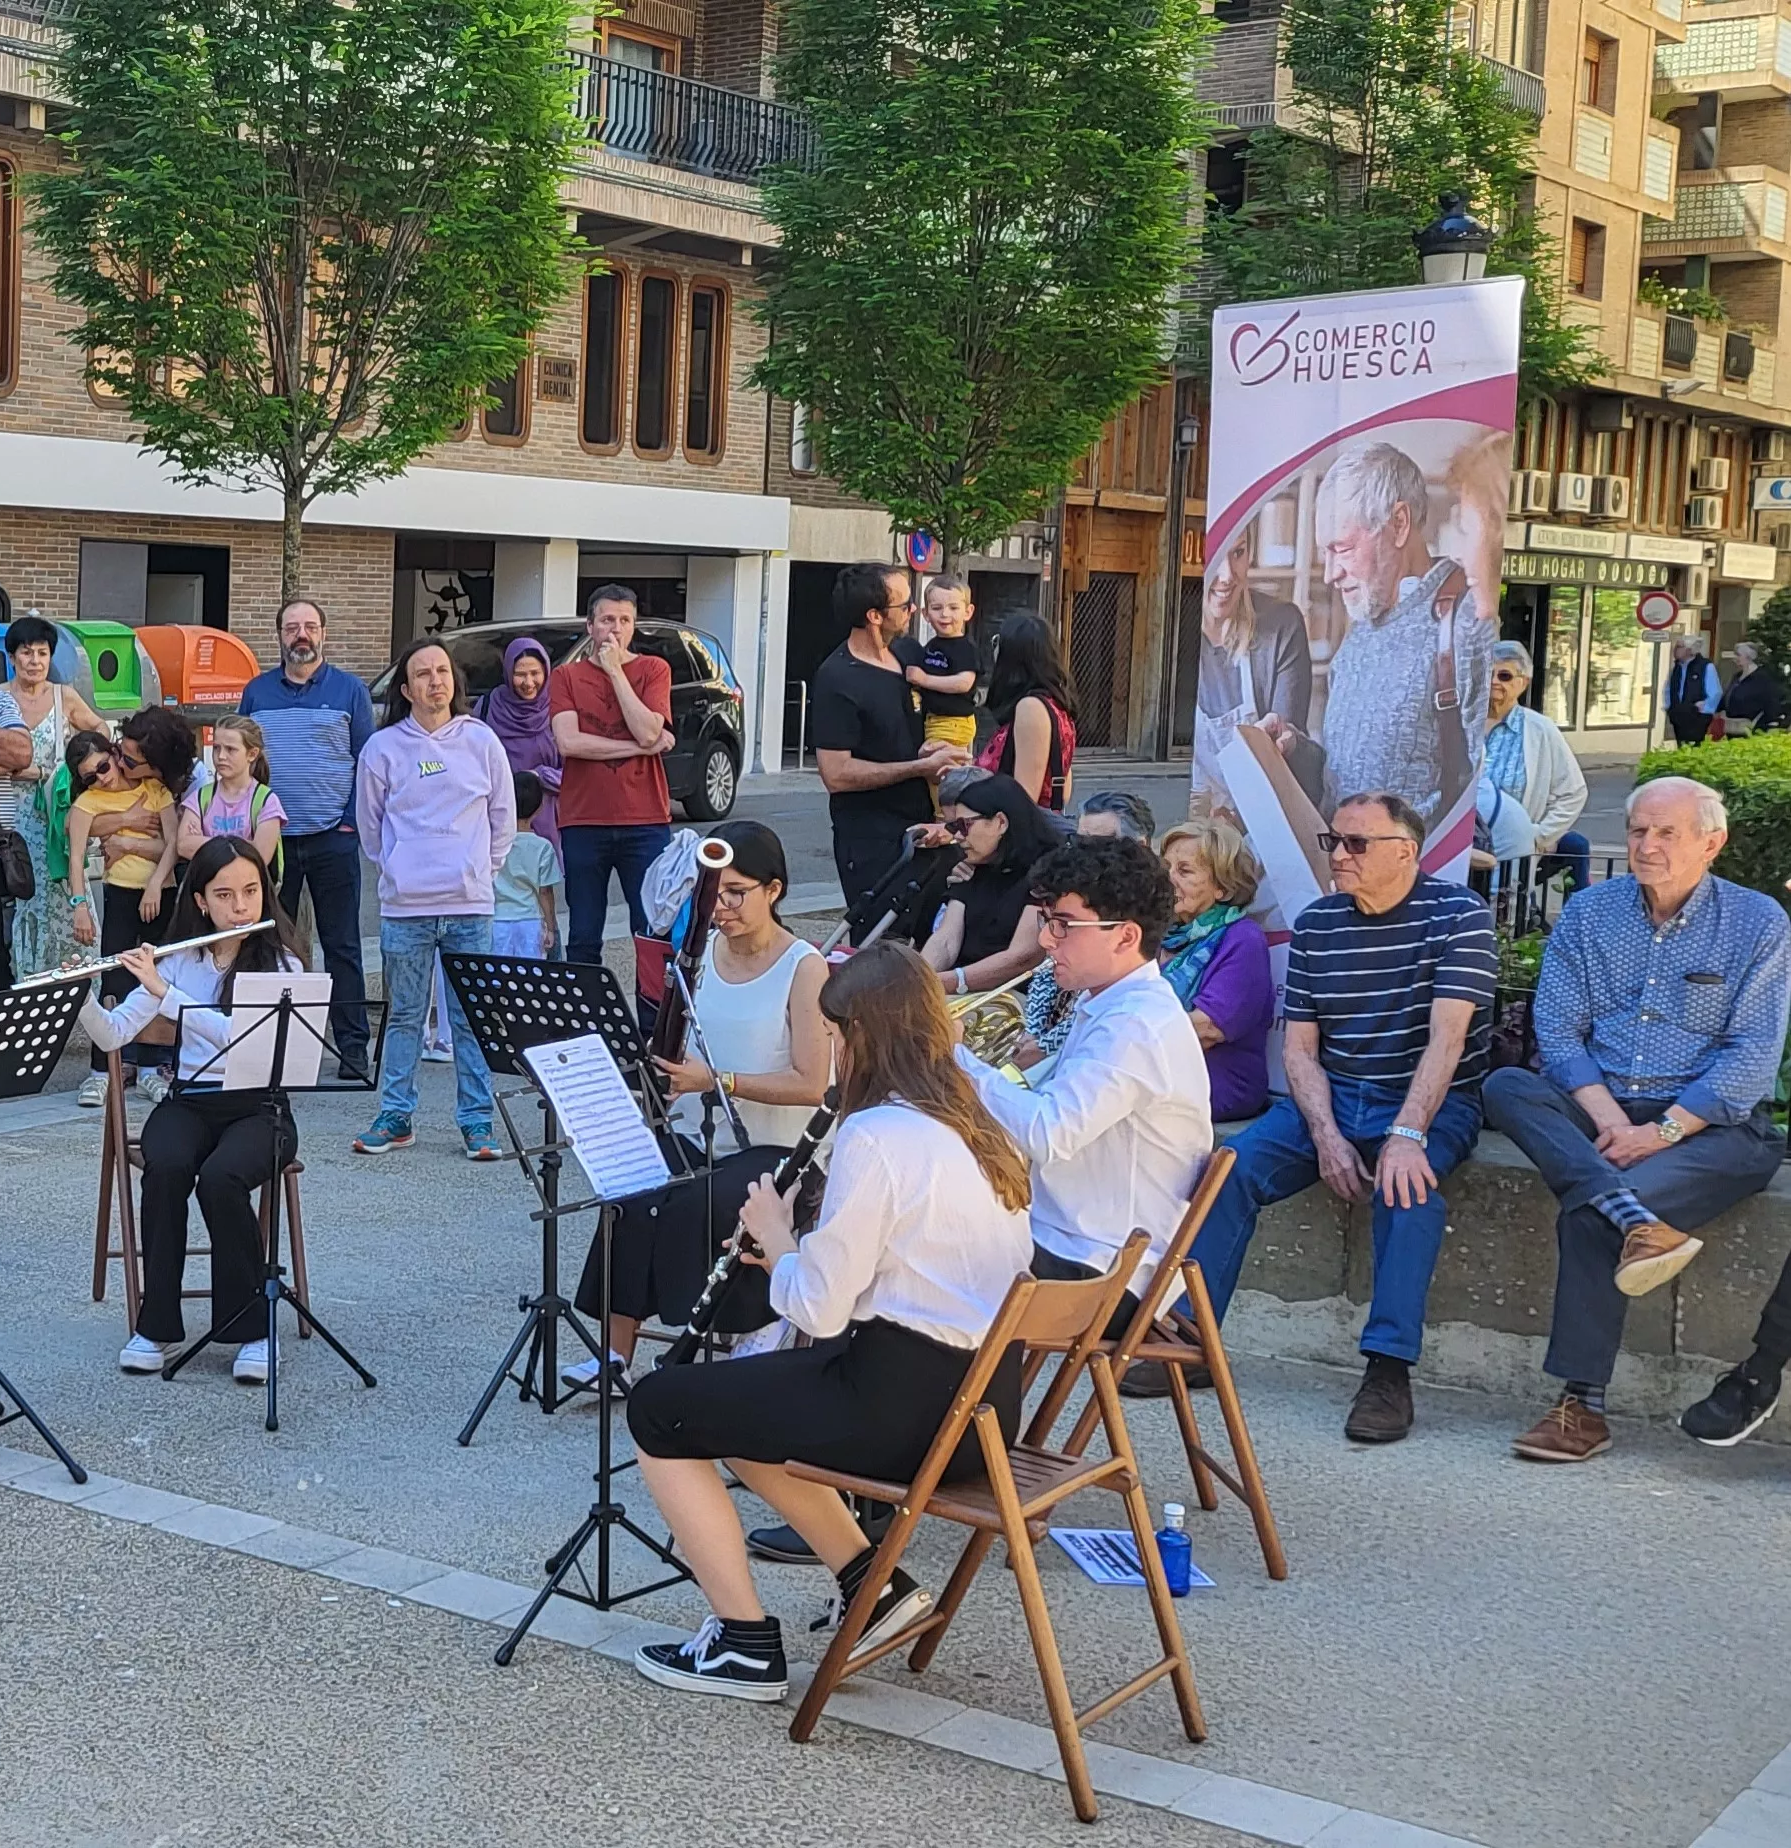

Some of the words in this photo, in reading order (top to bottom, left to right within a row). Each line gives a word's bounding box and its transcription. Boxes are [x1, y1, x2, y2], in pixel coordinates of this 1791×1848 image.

[1295, 320, 1436, 354] COMERCIO
[543, 361, 573, 379] CLINICA
[1293, 347, 1433, 384] HUESCA
[543, 380, 572, 397] DENTAL
[1542, 556, 1585, 579] HOGAR
